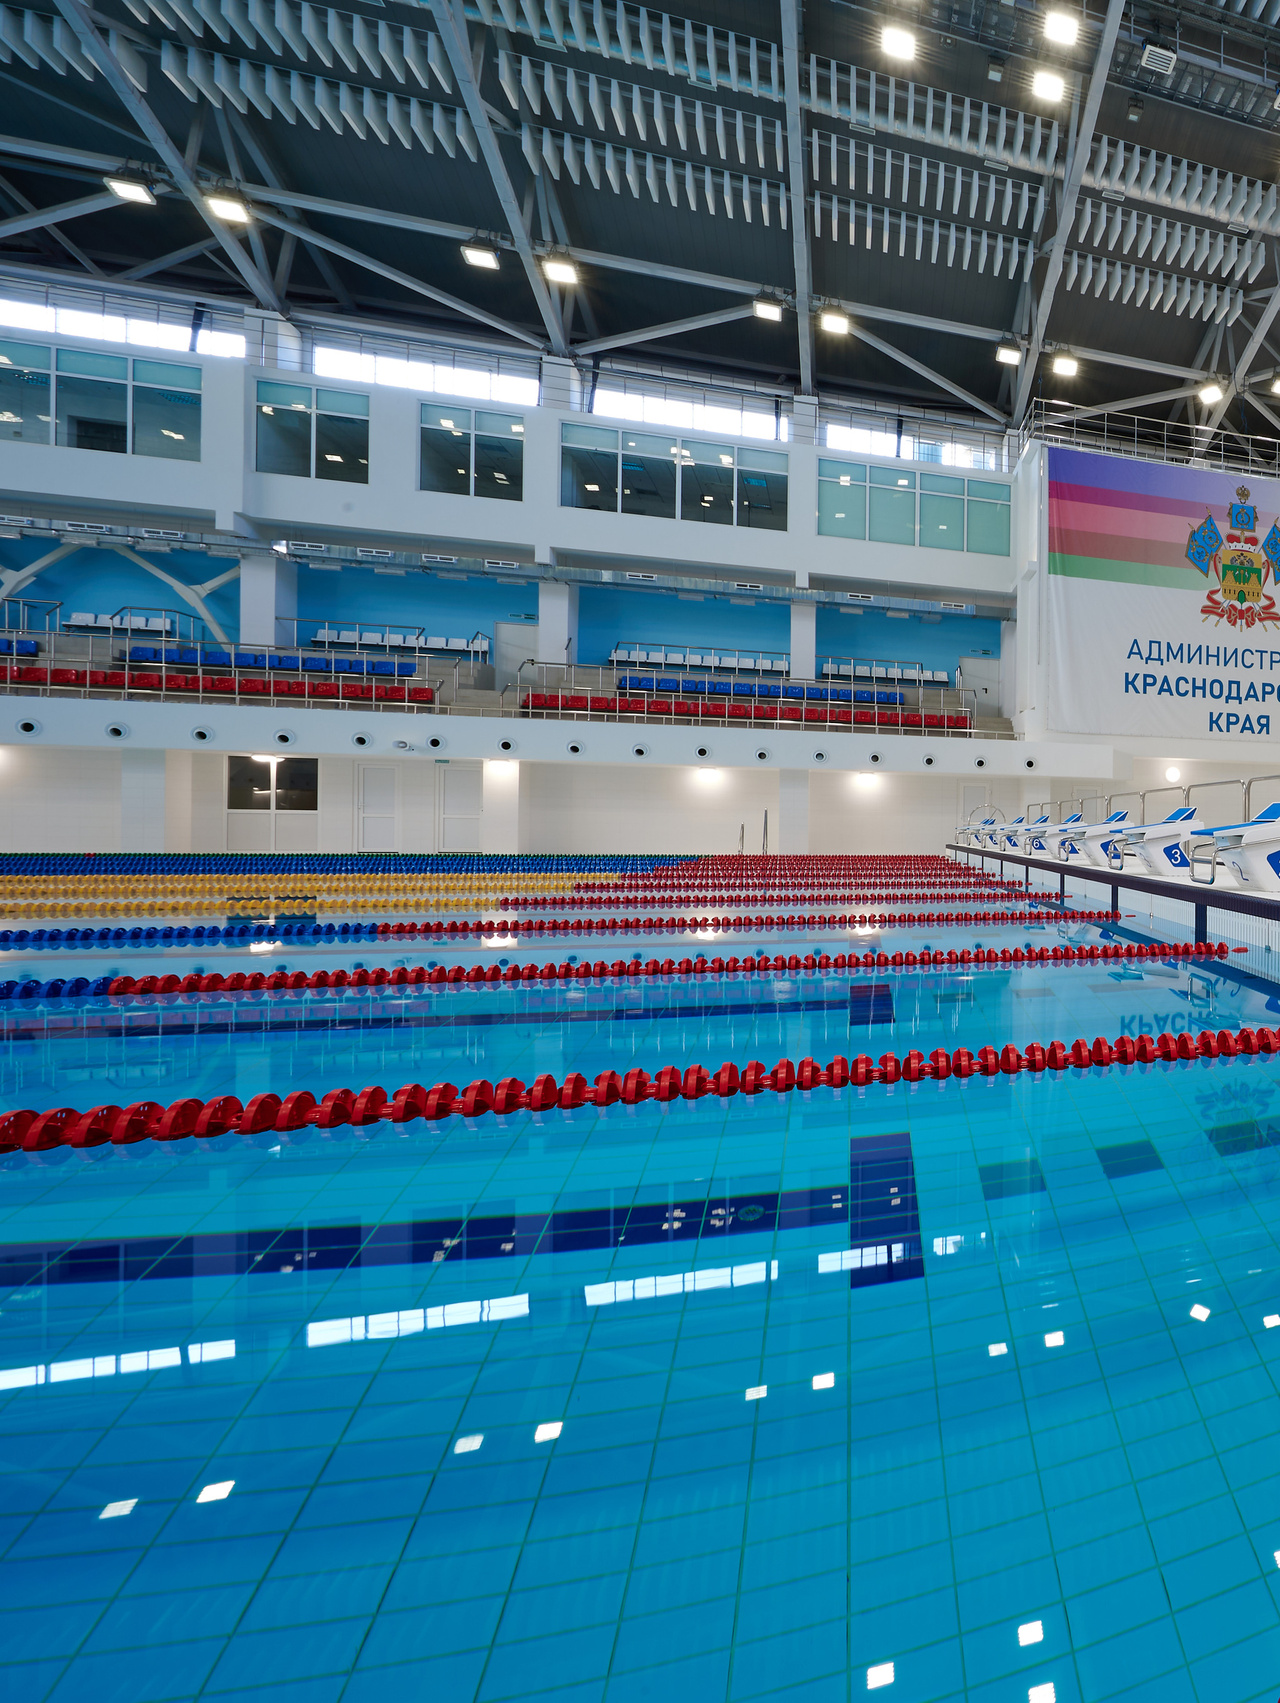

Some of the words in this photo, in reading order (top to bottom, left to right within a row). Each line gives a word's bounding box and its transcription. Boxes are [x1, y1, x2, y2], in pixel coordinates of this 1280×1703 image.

[1208, 711, 1271, 735] КРАЯ
[1033, 838, 1040, 848] 6
[1170, 849, 1181, 864] 3
[1232, 861, 1249, 881] 2
